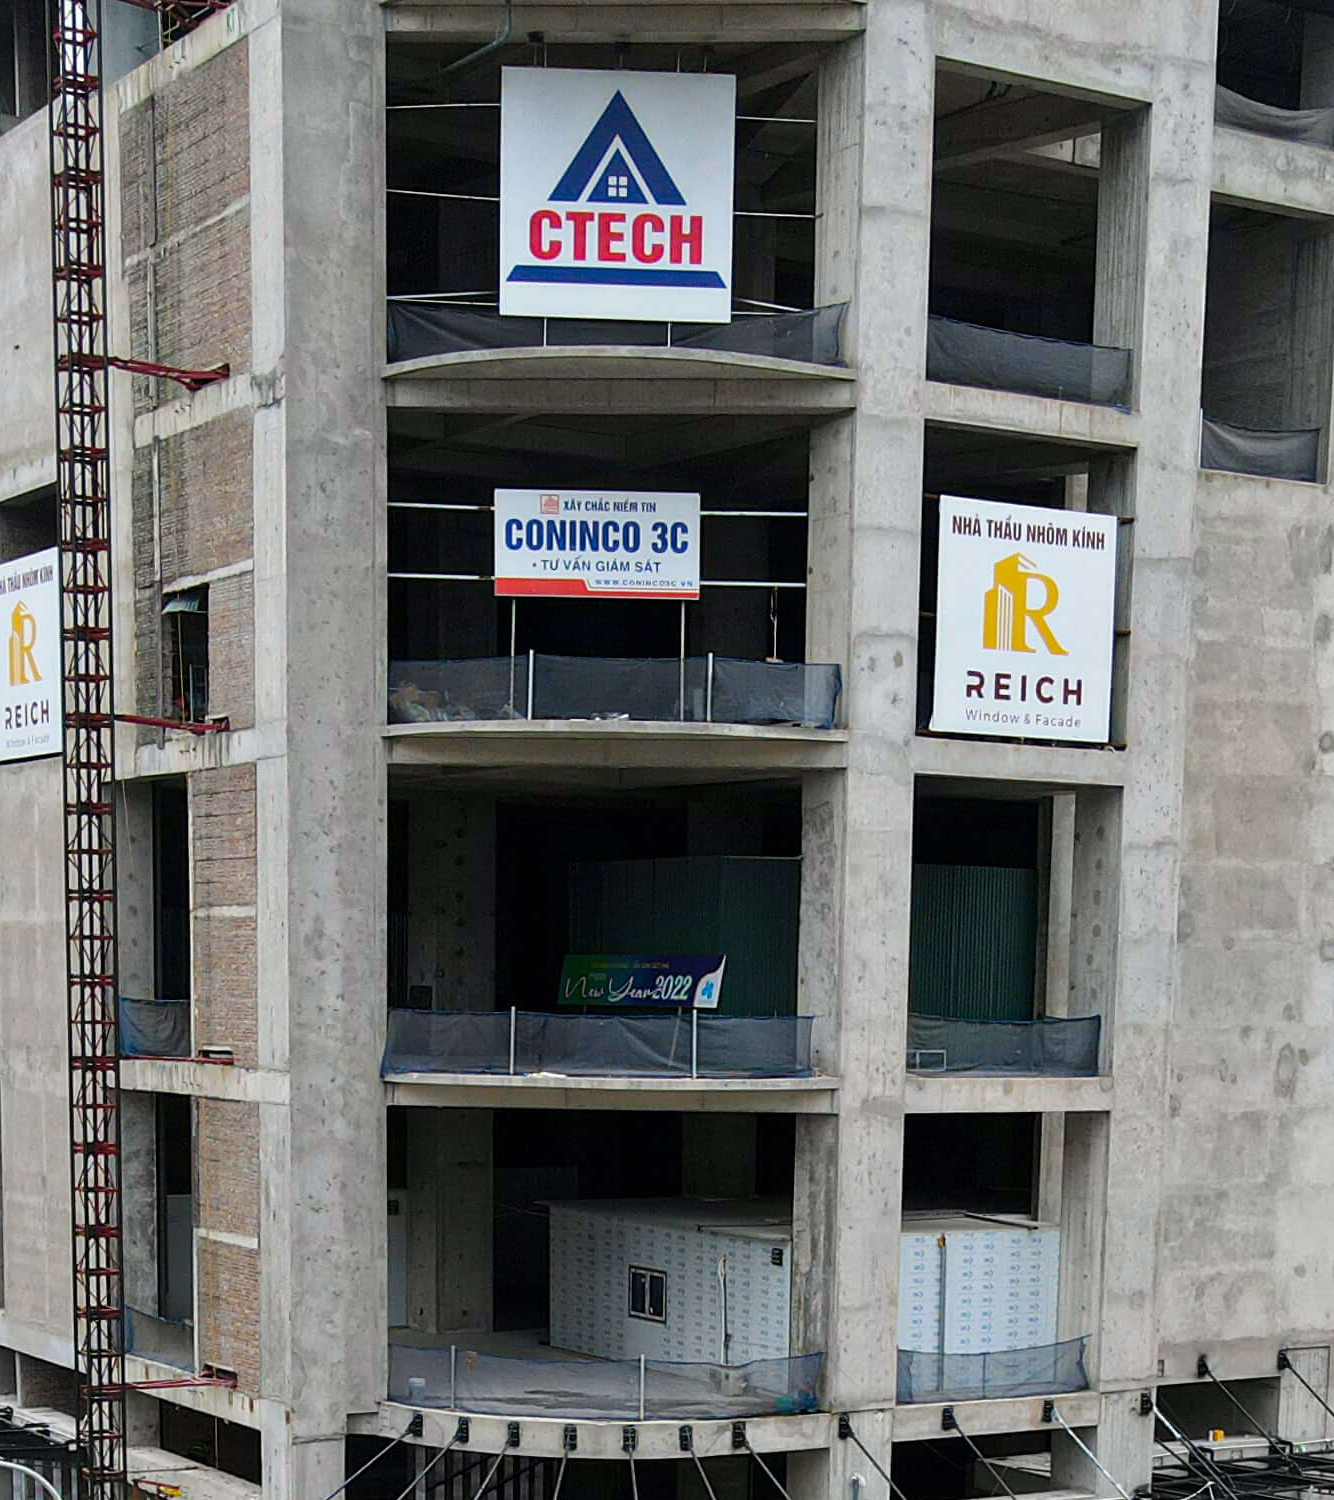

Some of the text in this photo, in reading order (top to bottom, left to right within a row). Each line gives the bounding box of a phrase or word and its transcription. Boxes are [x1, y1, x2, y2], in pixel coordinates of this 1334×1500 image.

[529, 209, 703, 265] CTECH
[641, 502, 657, 512] TIN
[505, 518, 689, 553] CONINCO 3C
[952, 515, 982, 537] NHÀ
[1026, 521, 1068, 547] NHÔM
[1072, 526, 1105, 551] KÍNH
[541, 555, 662, 573] TƯ VẤN GIÁM SÁT
[966, 670, 1083, 706] REICH
[5, 699, 50, 730] REICH
[966, 708, 1081, 729] Window & Facade
[565, 975, 693, 1002] New Year 2022
